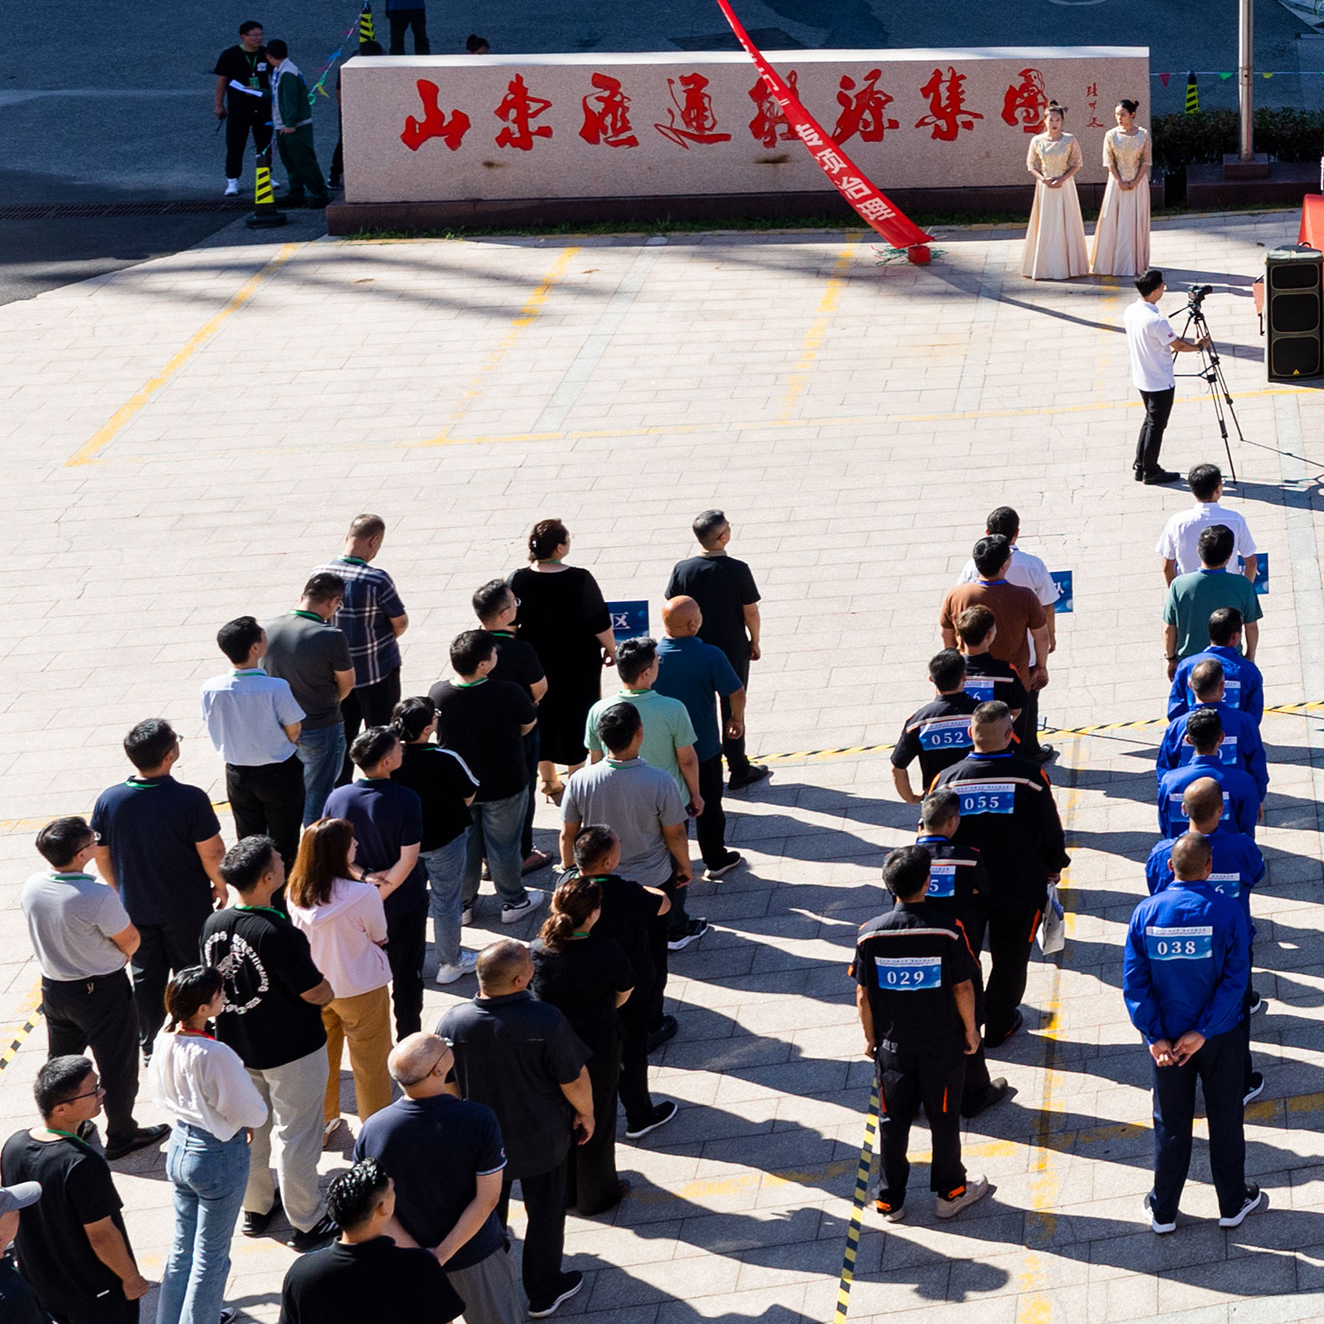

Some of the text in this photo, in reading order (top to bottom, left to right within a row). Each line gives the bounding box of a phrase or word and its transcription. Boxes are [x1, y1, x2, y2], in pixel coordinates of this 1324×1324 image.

[931, 730, 964, 746] 052
[964, 794, 1000, 811] 055
[1156, 940, 1197, 957] 038
[886, 968, 925, 986] 029
